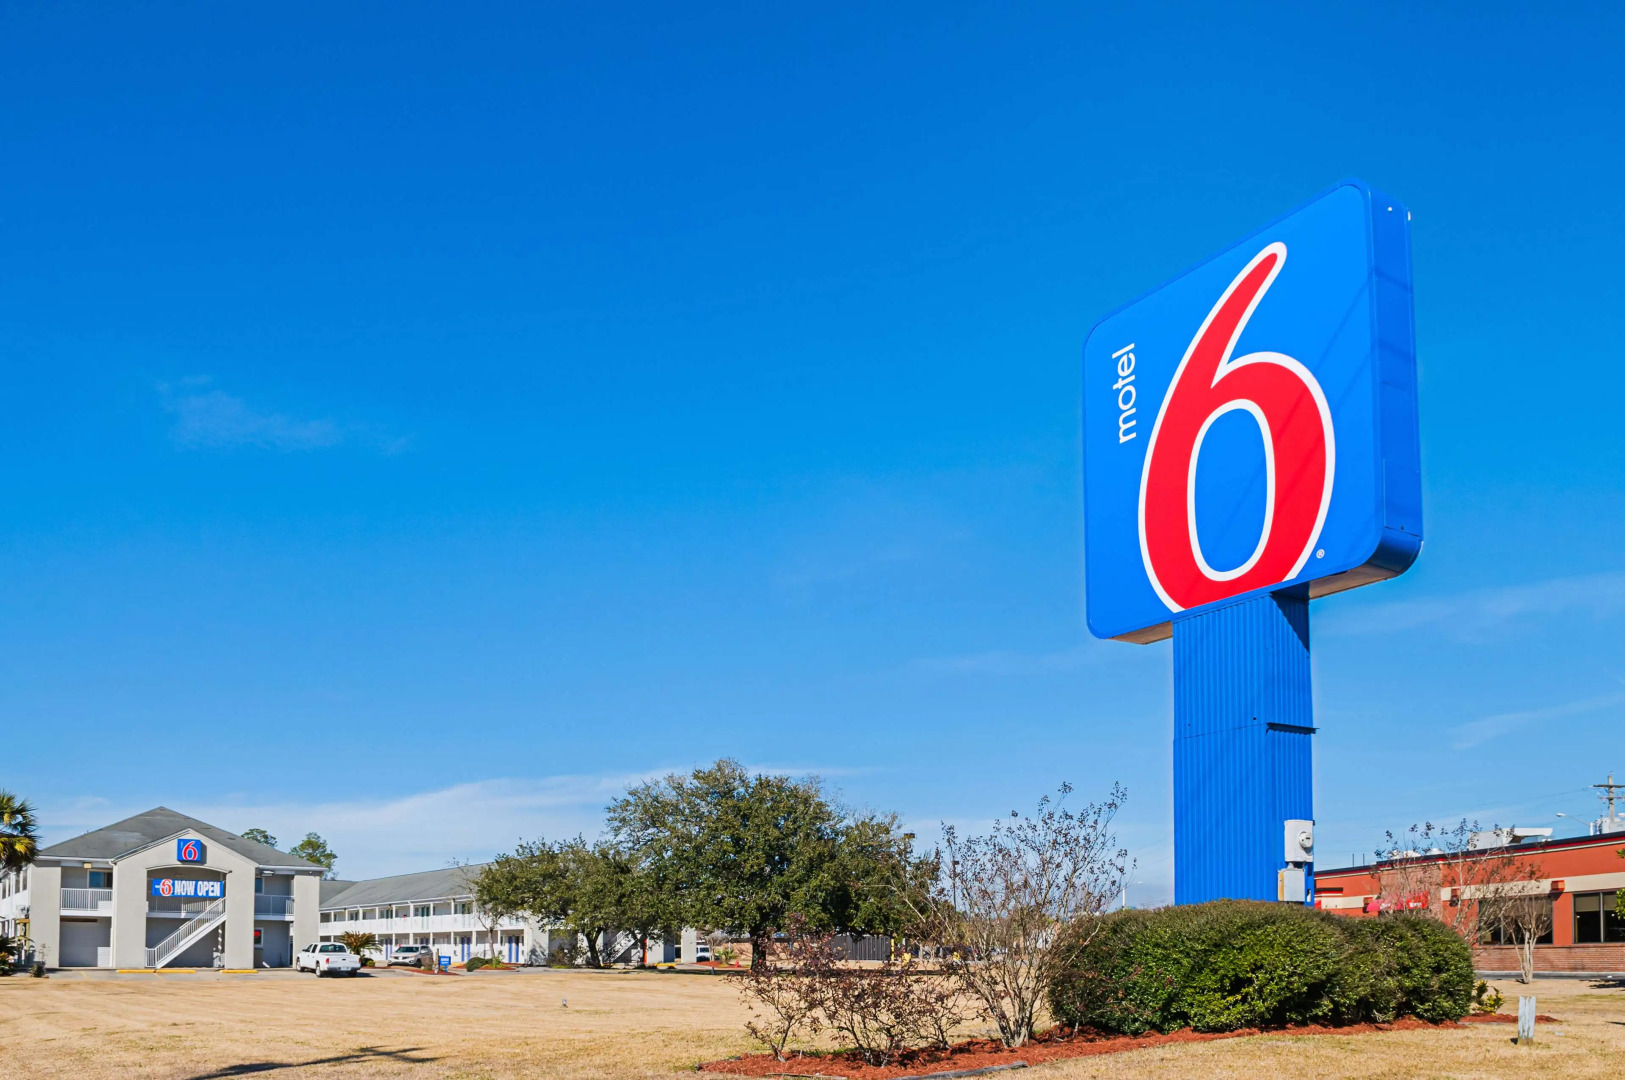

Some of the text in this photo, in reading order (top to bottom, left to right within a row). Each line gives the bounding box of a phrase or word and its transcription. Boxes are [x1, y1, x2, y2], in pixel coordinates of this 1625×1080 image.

[1112, 343, 1136, 444] motel
[1138, 241, 1336, 613] 6
[182, 841, 198, 860] 6
[160, 878, 220, 897] 6 NOW OPEN
